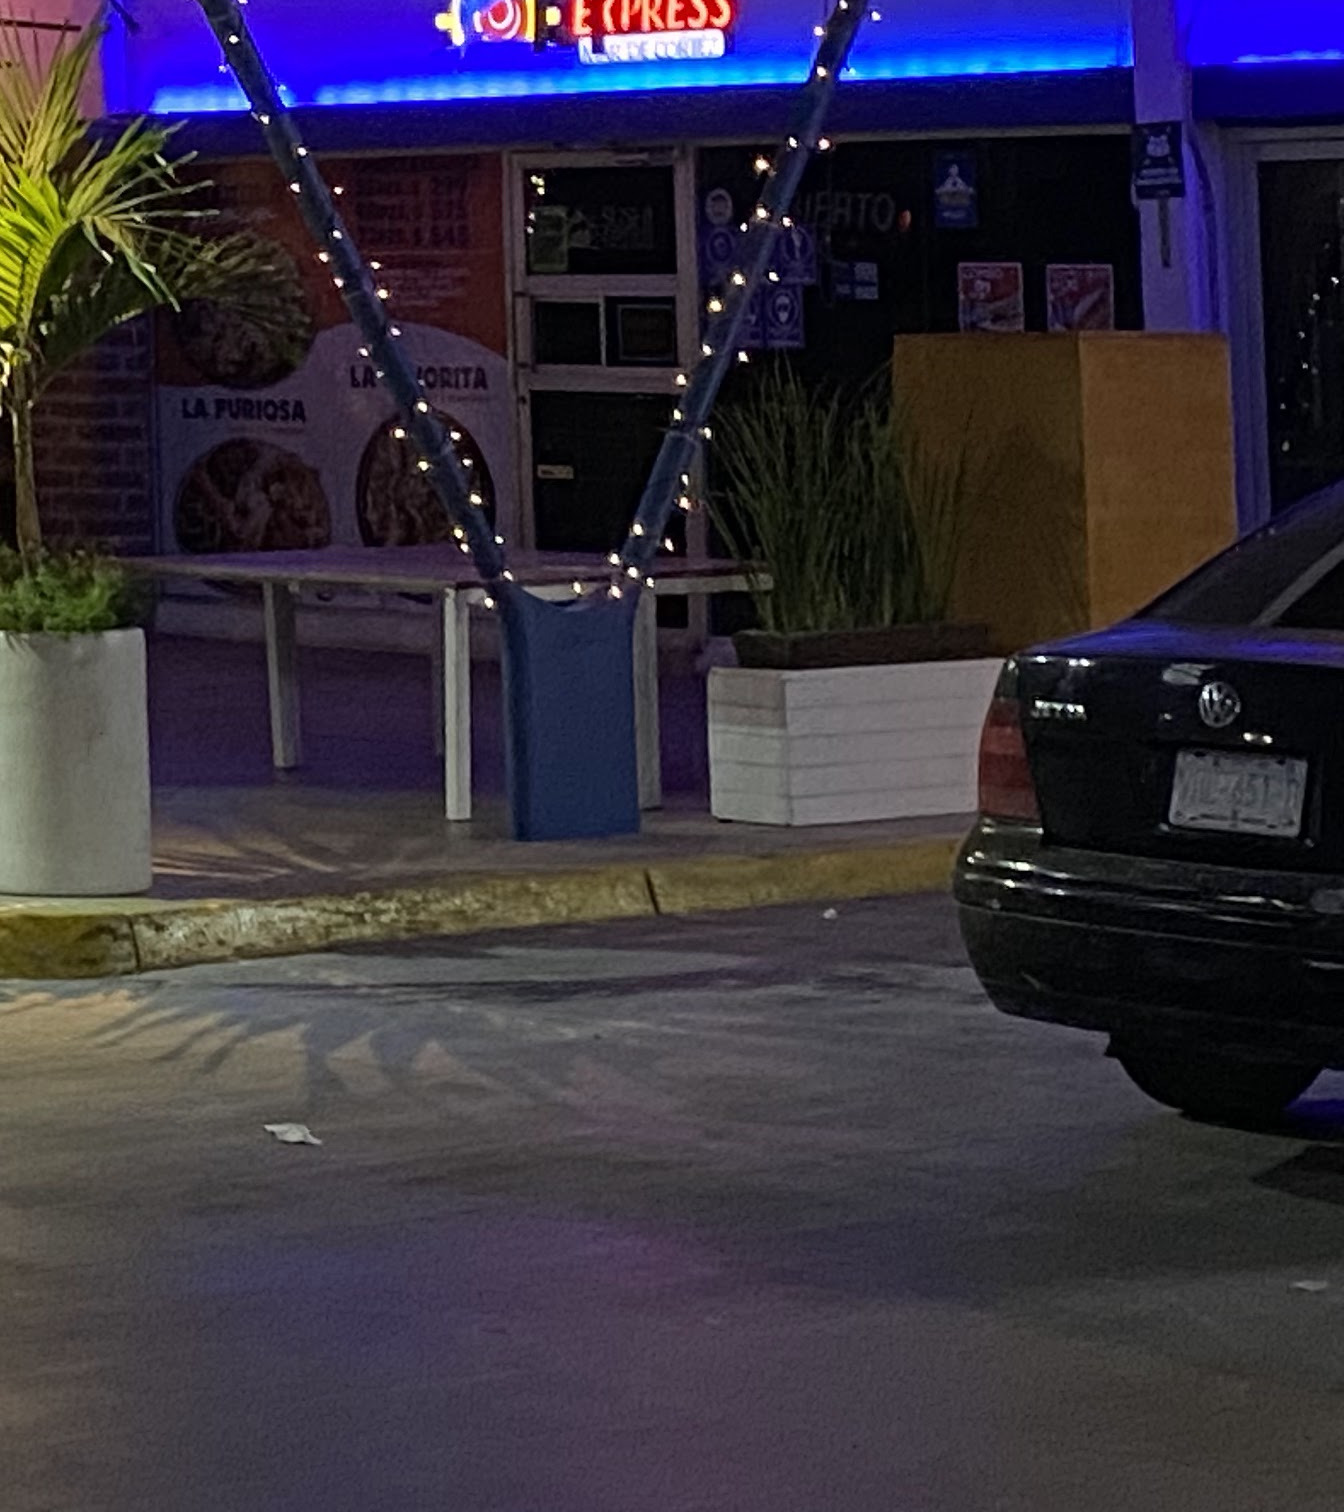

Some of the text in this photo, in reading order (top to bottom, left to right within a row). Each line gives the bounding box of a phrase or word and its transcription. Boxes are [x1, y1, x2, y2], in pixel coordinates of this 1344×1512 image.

[349, 364, 377, 389] LA
[181, 397, 307, 423] LA FURIOSA
